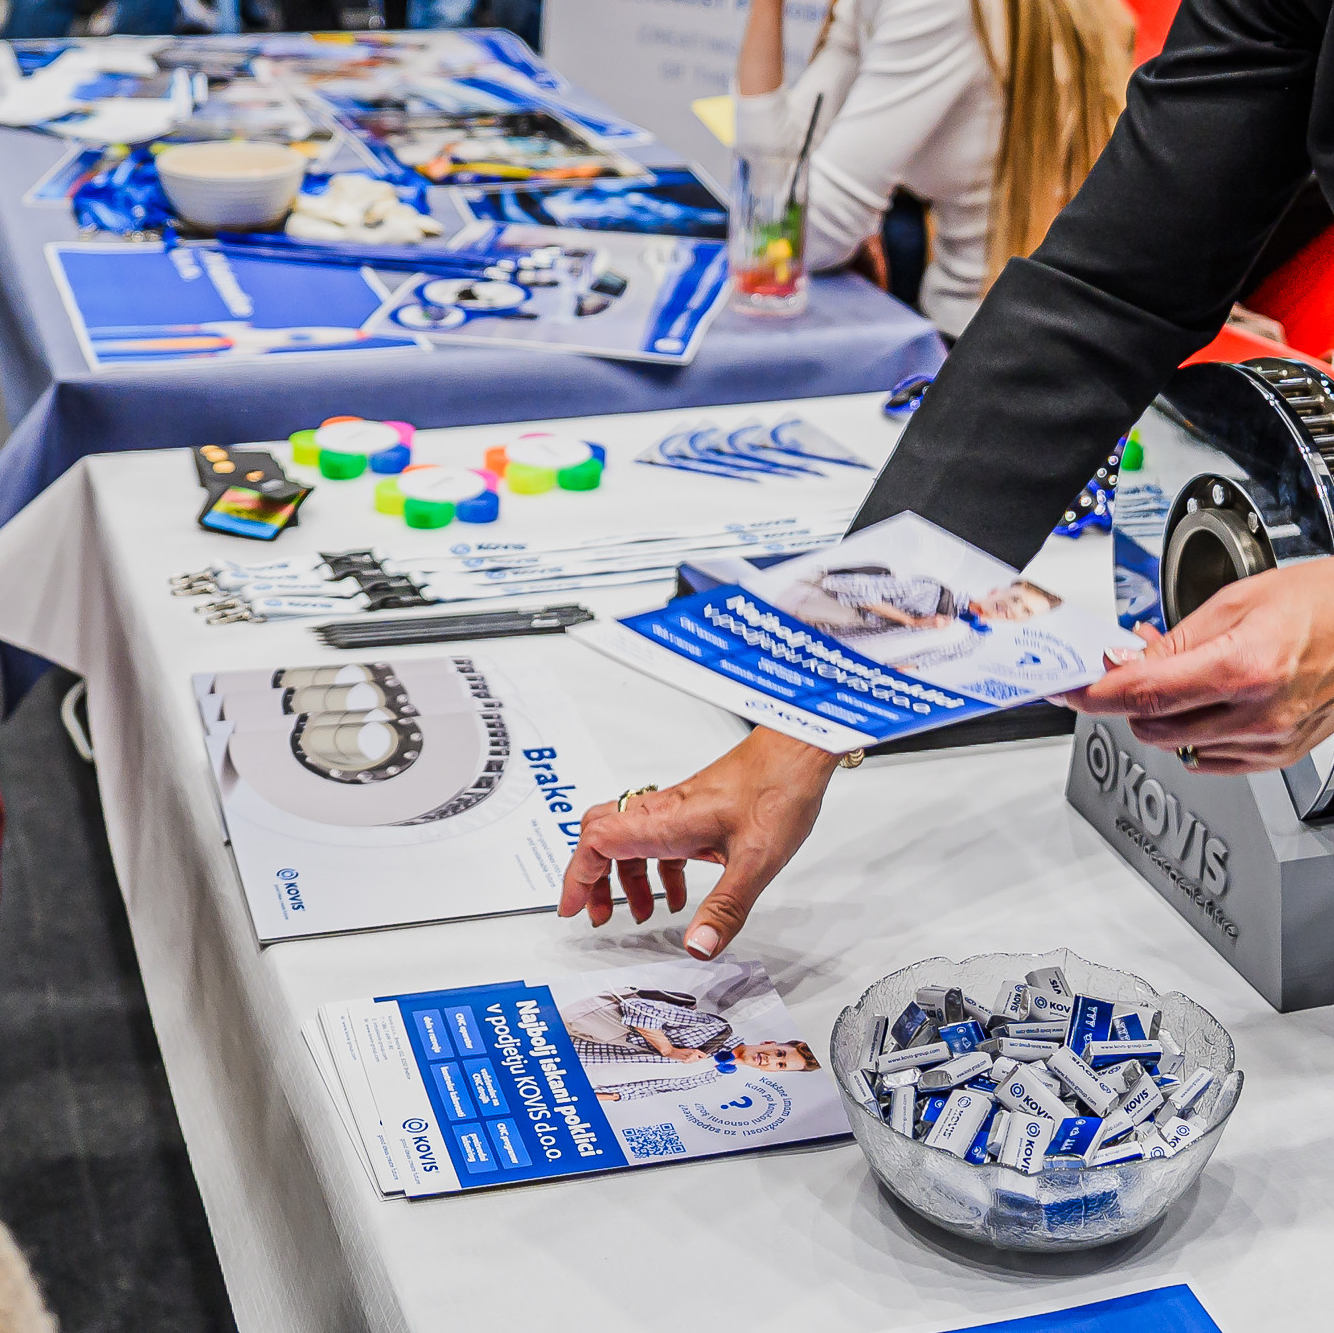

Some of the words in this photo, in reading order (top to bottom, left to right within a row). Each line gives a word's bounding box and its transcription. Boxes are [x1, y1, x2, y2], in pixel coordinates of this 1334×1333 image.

[522, 747, 577, 813] Brake
[1118, 750, 1229, 896] KOVIS
[284, 882, 305, 911] KOVIS
[455, 1012, 467, 1026] CNC
[486, 1002, 503, 1014] v
[1049, 1001, 1071, 1013] KOV
[515, 999, 558, 1057] Najbolj
[484, 1015, 528, 1075] podjetju
[887, 1048, 941, 1064] www.kovis-group.com
[1100, 1042, 1153, 1050] www.kovis-group.com
[472, 1072, 484, 1086] CNC
[538, 1057, 579, 1104] iskani
[1071, 1057, 1099, 1082] KOVIS
[514, 1076, 552, 1121] KOVIS
[744, 1082, 766, 1095] Kam
[759, 1076, 788, 1098] Kakšne
[1053, 1066, 1097, 1107] www.kovis-group.com
[449, 1091, 466, 1118] kakovosti
[1123, 1088, 1149, 1114] KOVIS
[496, 1122, 509, 1136] CNC
[553, 1104, 604, 1157] poklici
[710, 1114, 750, 1127] osnovni
[742, 1116, 785, 1136] možnosti
[412, 1135, 439, 1173] KOVIS
[499, 1135, 519, 1164] programer
[534, 1122, 562, 1163] d.o.o.
